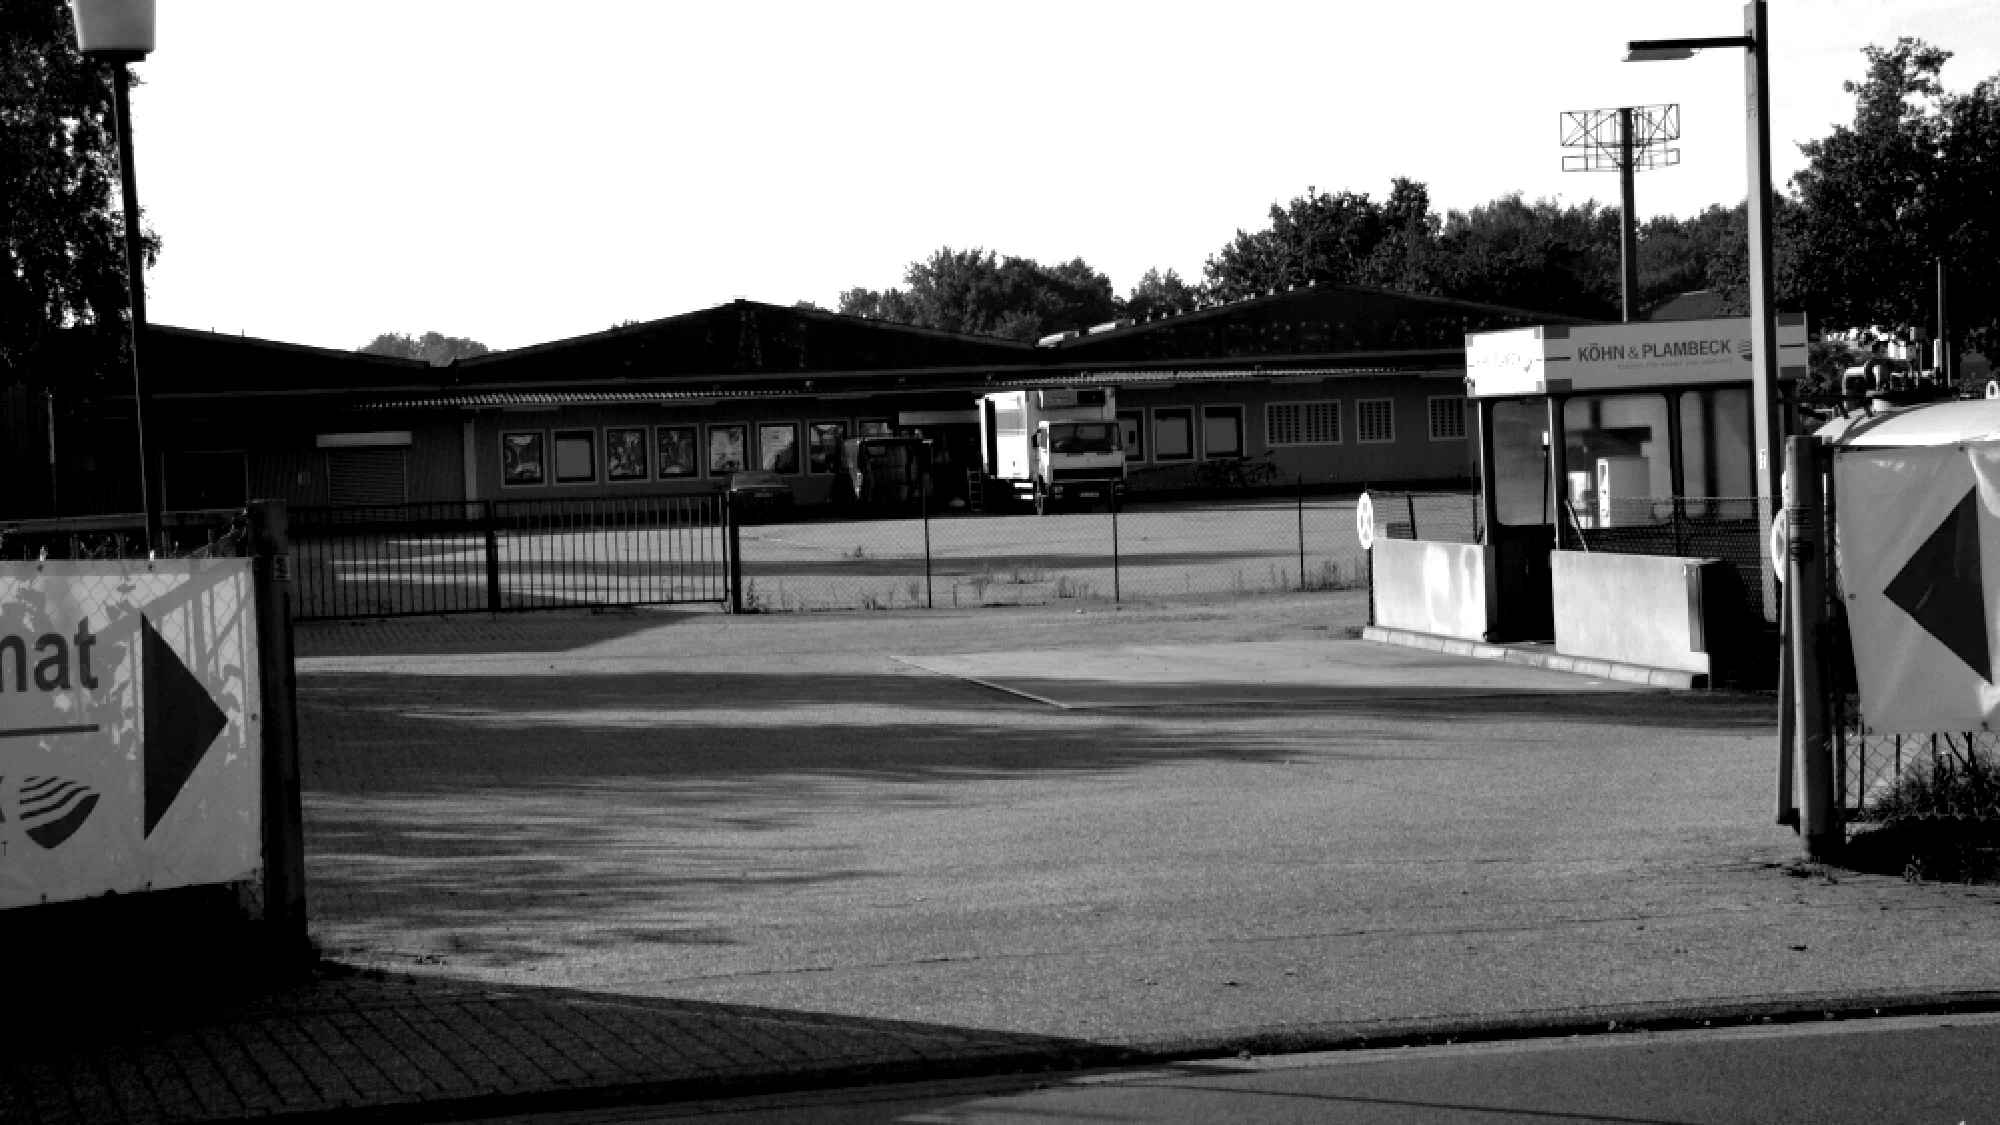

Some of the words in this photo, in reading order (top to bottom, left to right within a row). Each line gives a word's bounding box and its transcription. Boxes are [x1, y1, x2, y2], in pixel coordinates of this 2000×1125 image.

[1577, 342, 1625, 362] KÖHN
[1628, 345, 1639, 360] &
[1642, 338, 1732, 359] PLAMBECK
